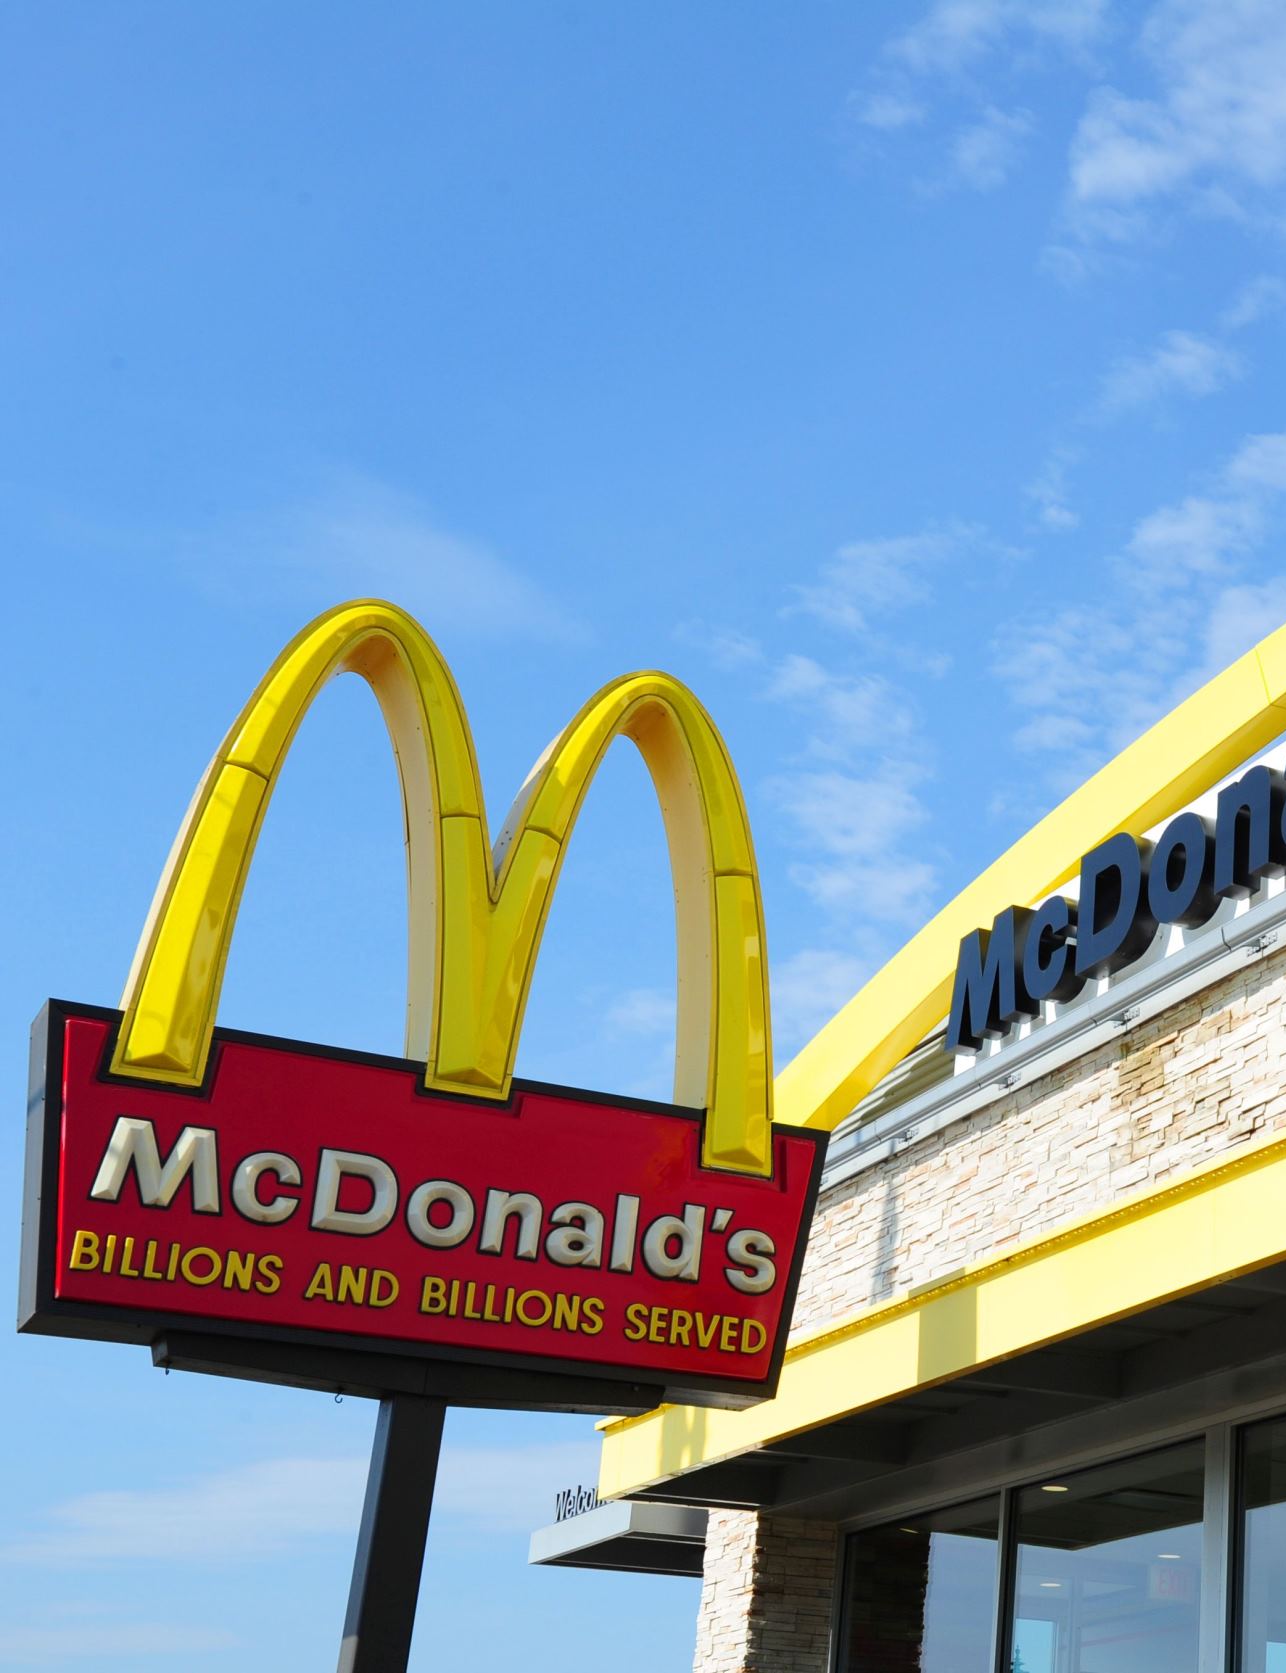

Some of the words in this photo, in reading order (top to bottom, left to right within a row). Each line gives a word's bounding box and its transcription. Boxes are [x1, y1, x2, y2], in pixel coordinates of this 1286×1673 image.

[89, 1115, 777, 1295] McDonald's
[69, 1230, 284, 1294] BILLIONS
[305, 1262, 399, 1308] AND
[421, 1276, 604, 1334] BILLIONS
[624, 1302, 767, 1355] SERVED
